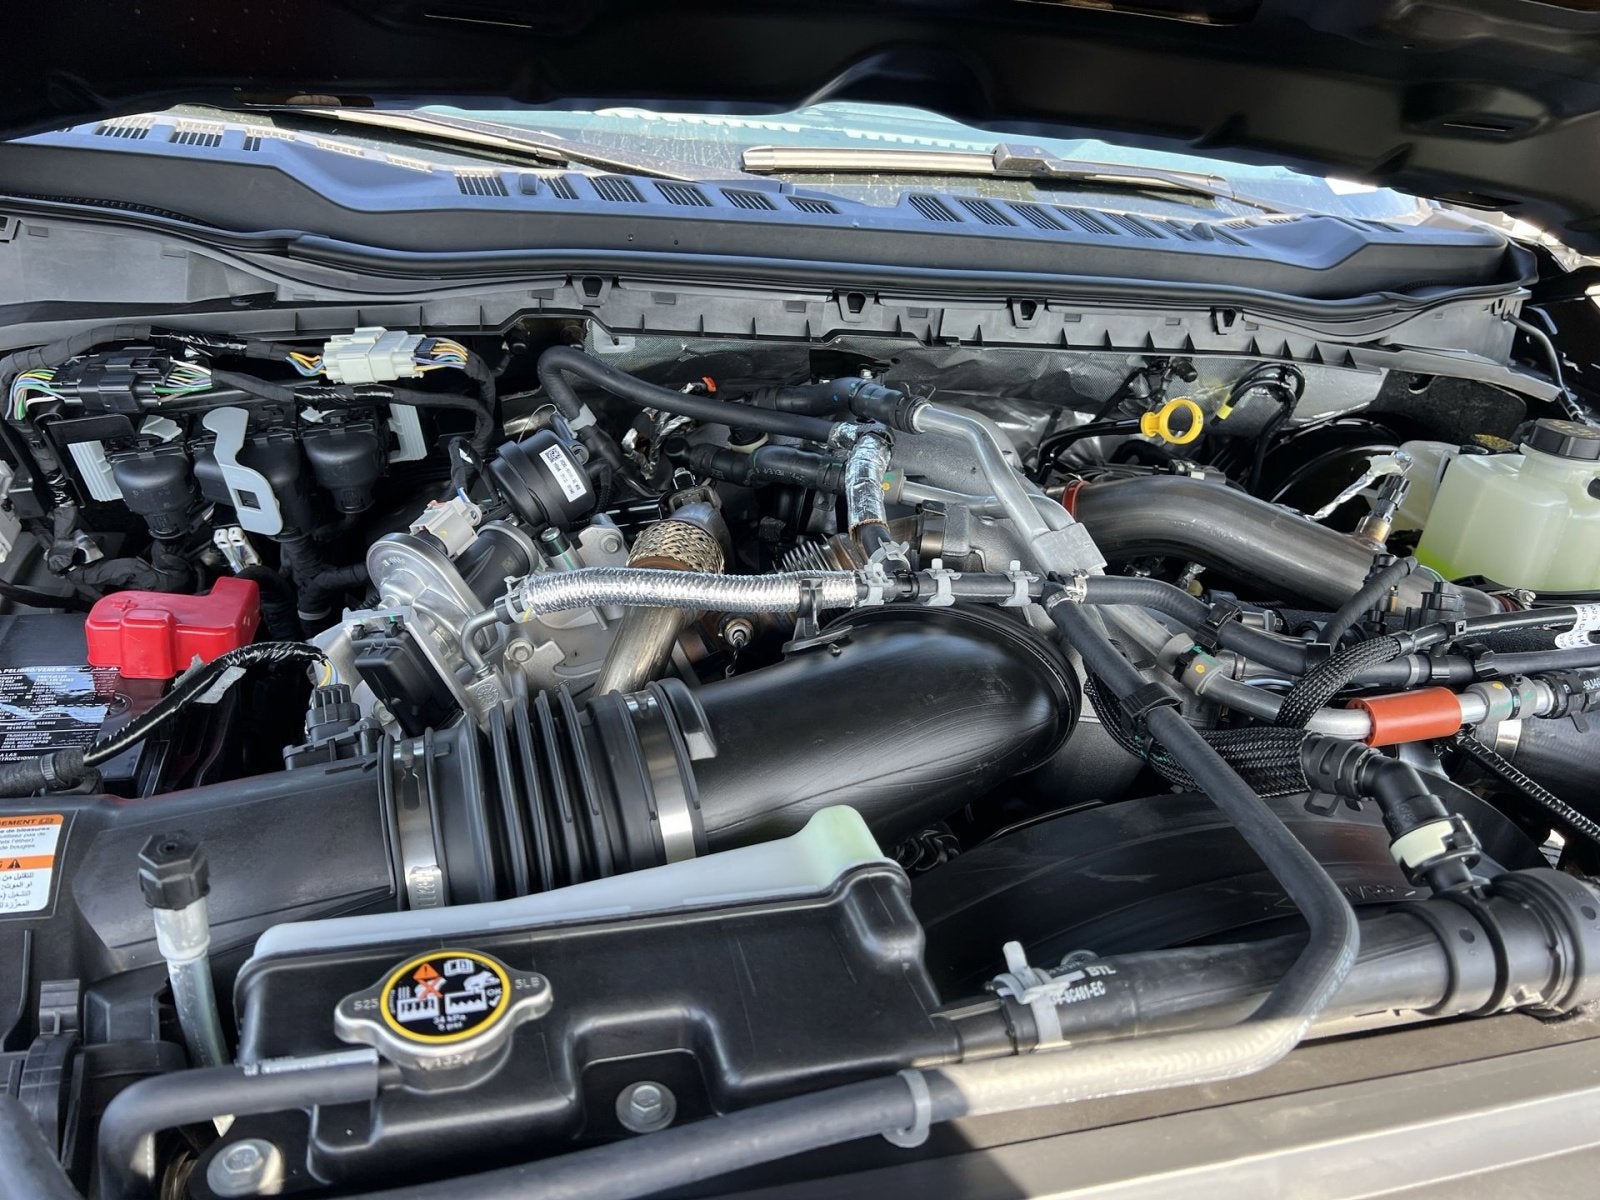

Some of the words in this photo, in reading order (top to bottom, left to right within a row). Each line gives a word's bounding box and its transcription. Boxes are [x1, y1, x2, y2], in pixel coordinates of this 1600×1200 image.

[0, 818, 37, 827] EMENT
[1086, 965, 1117, 977] BTL
[353, 998, 379, 1011] S25
